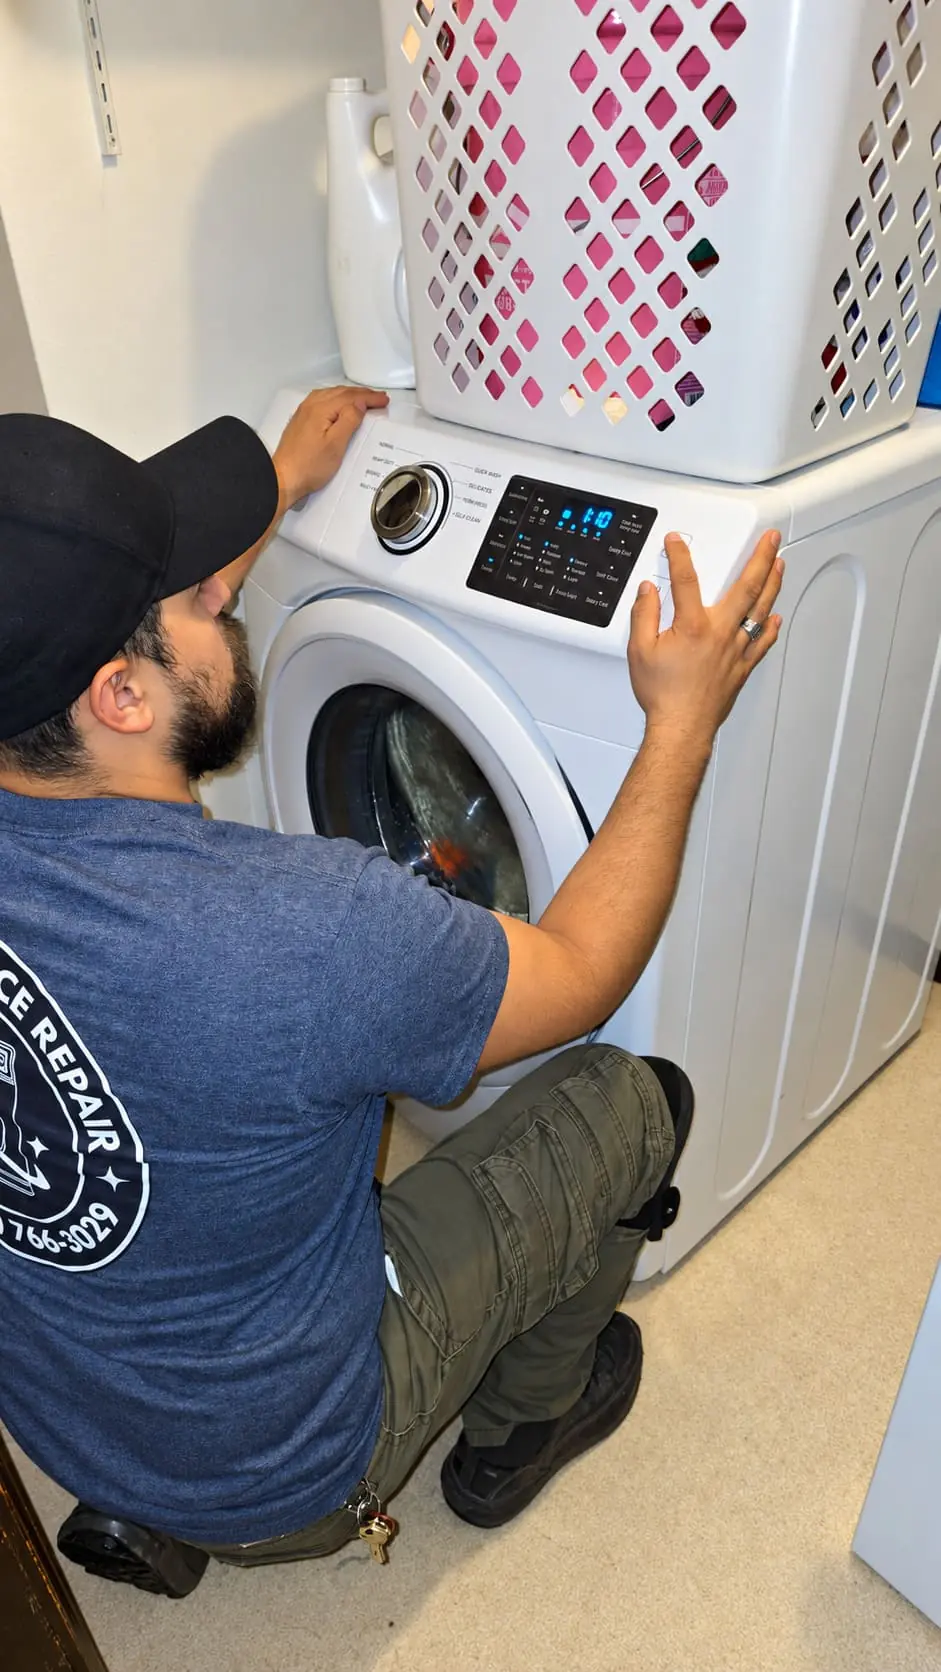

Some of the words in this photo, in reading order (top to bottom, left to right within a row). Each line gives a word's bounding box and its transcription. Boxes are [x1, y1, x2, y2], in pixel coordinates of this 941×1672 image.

[583, 507, 613, 529] 1:10
[30, 1016, 120, 1154] REPAIR
[7, 1202, 119, 1253] 766-3029
